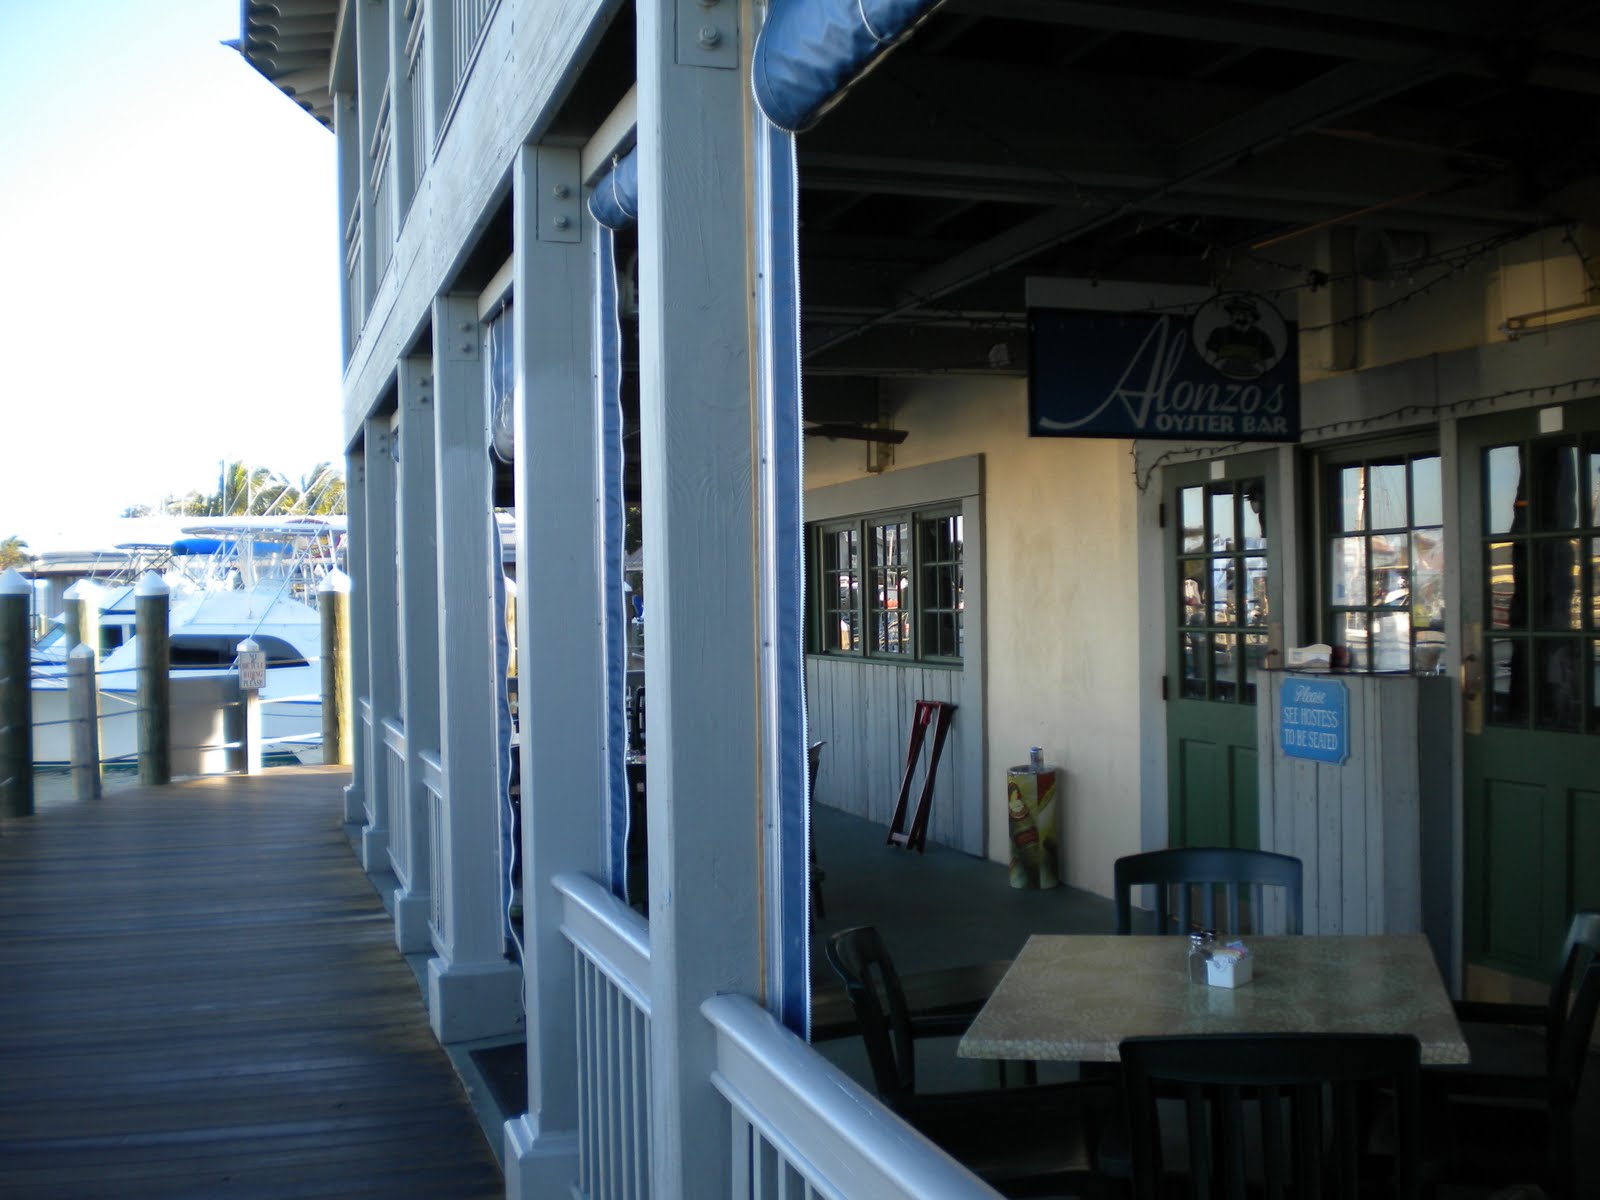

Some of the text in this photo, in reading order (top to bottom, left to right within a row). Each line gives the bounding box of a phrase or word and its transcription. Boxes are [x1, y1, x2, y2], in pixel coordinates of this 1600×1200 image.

[1155, 413, 1289, 435] OYSTER BAR
[1295, 685, 1326, 704] Please
[1284, 707, 1338, 728] SEE HOSTESS
[1284, 728, 1338, 750] TO BE SEATED
